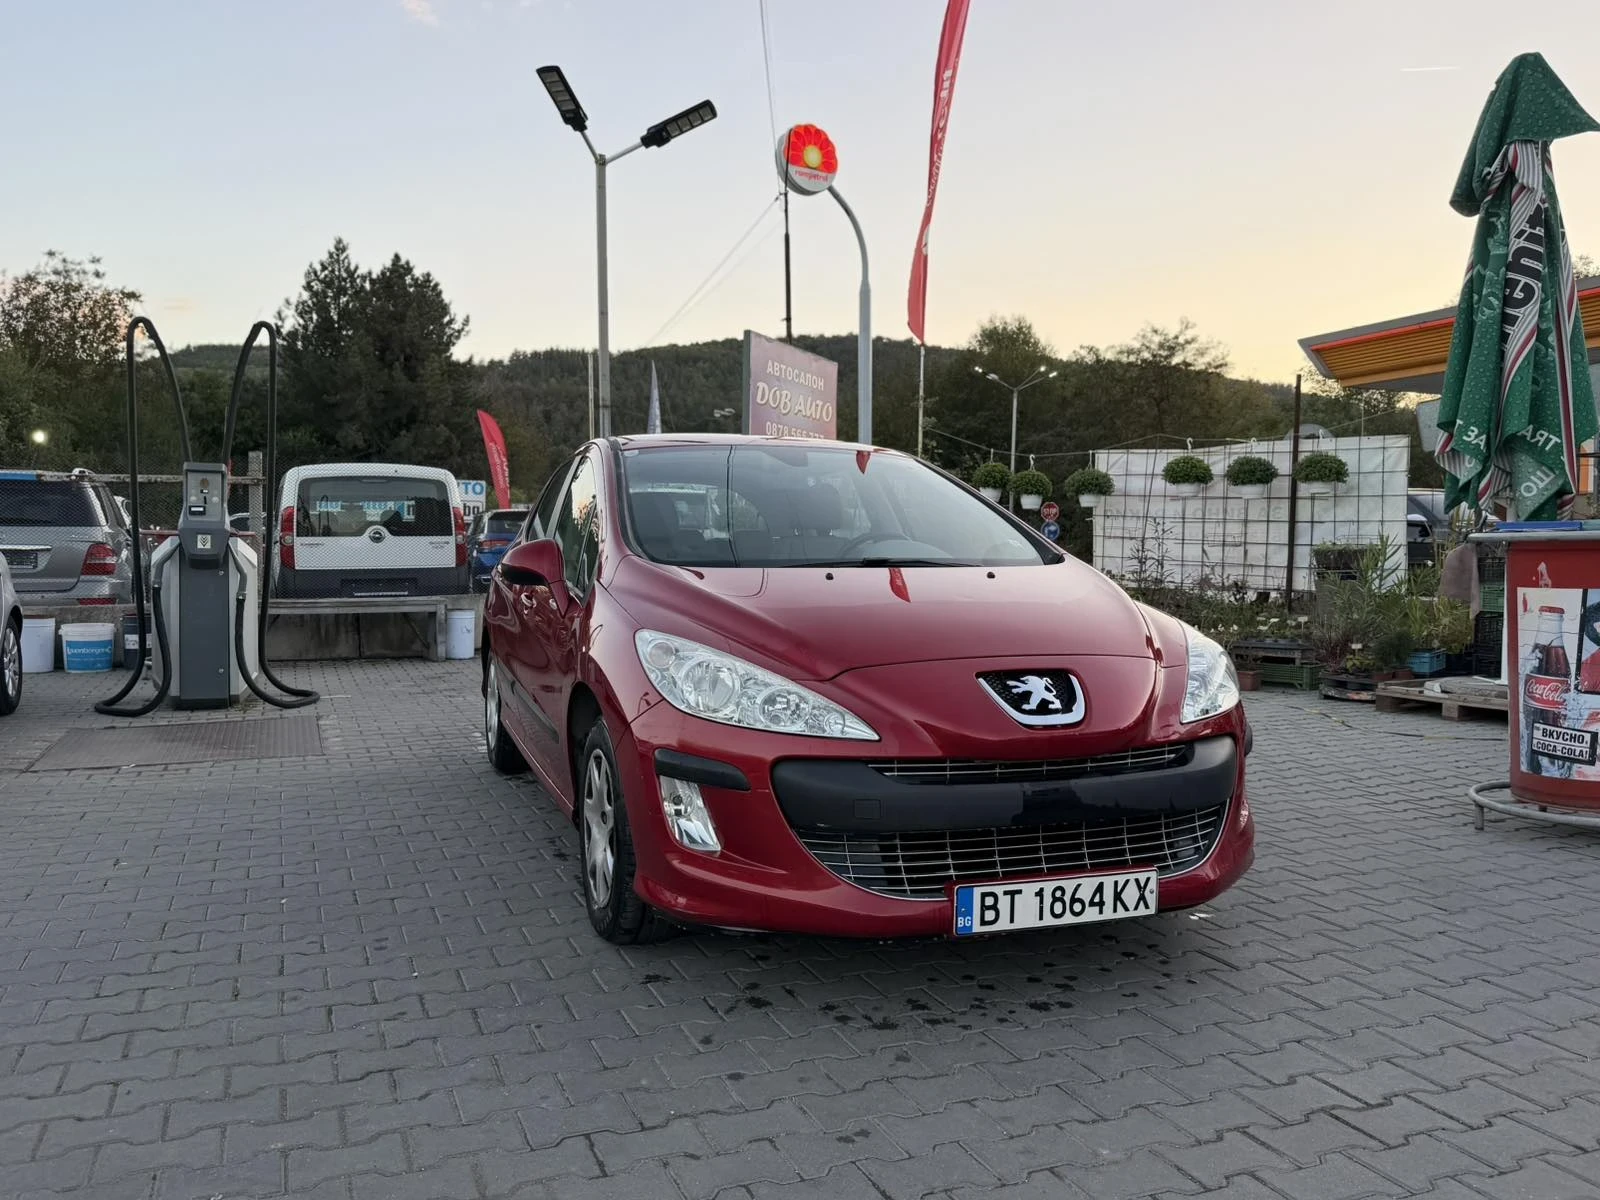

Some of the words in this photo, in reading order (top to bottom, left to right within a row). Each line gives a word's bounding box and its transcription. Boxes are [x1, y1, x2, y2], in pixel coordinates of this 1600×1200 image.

[766, 360, 824, 391] АВТОСАЛОН
[756, 382, 792, 415] DOB
[1541, 727, 1585, 745] ВКУСНО
[1536, 741, 1588, 760] COCA-COLA!
[979, 889, 1023, 927] BT
[1034, 882, 1106, 922] 1864
[1112, 876, 1152, 914] KX
[957, 917, 972, 928] BG
